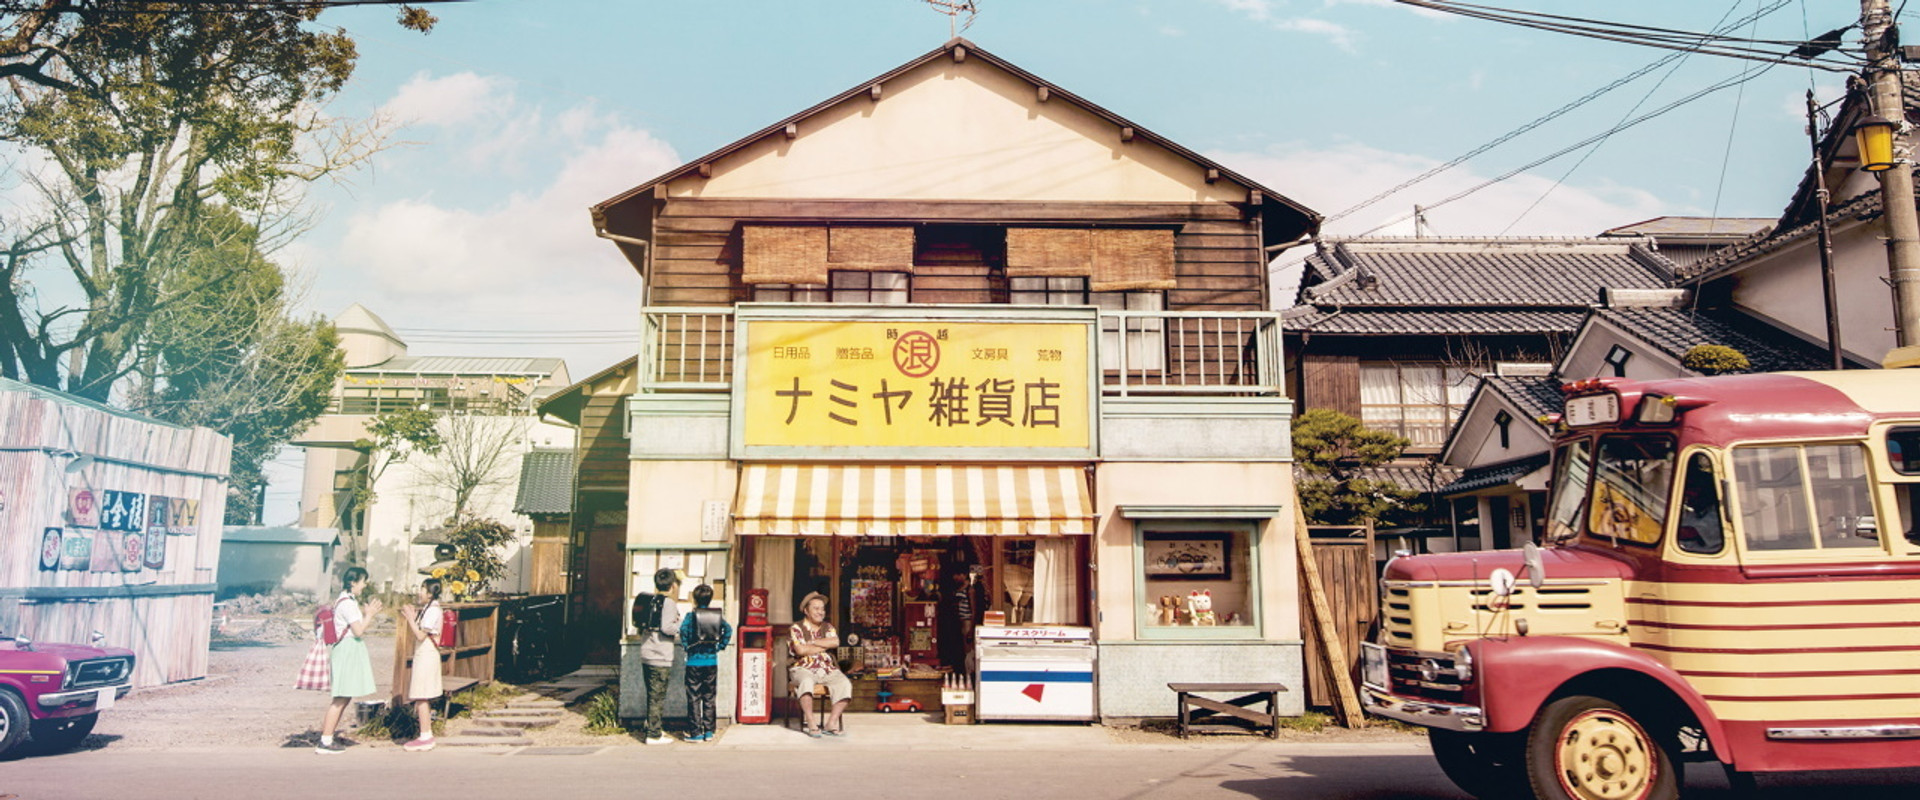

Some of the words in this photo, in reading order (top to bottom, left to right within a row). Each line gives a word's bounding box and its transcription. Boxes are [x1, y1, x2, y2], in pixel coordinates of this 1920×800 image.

[773, 346, 811, 360] 日用品
[835, 346, 875, 360] 贈答品
[971, 347, 1009, 361] 文房具
[1037, 348, 1062, 362] 荒物
[898, 336, 932, 371] 浪
[1003, 629, 1066, 638] アイスクリーム
